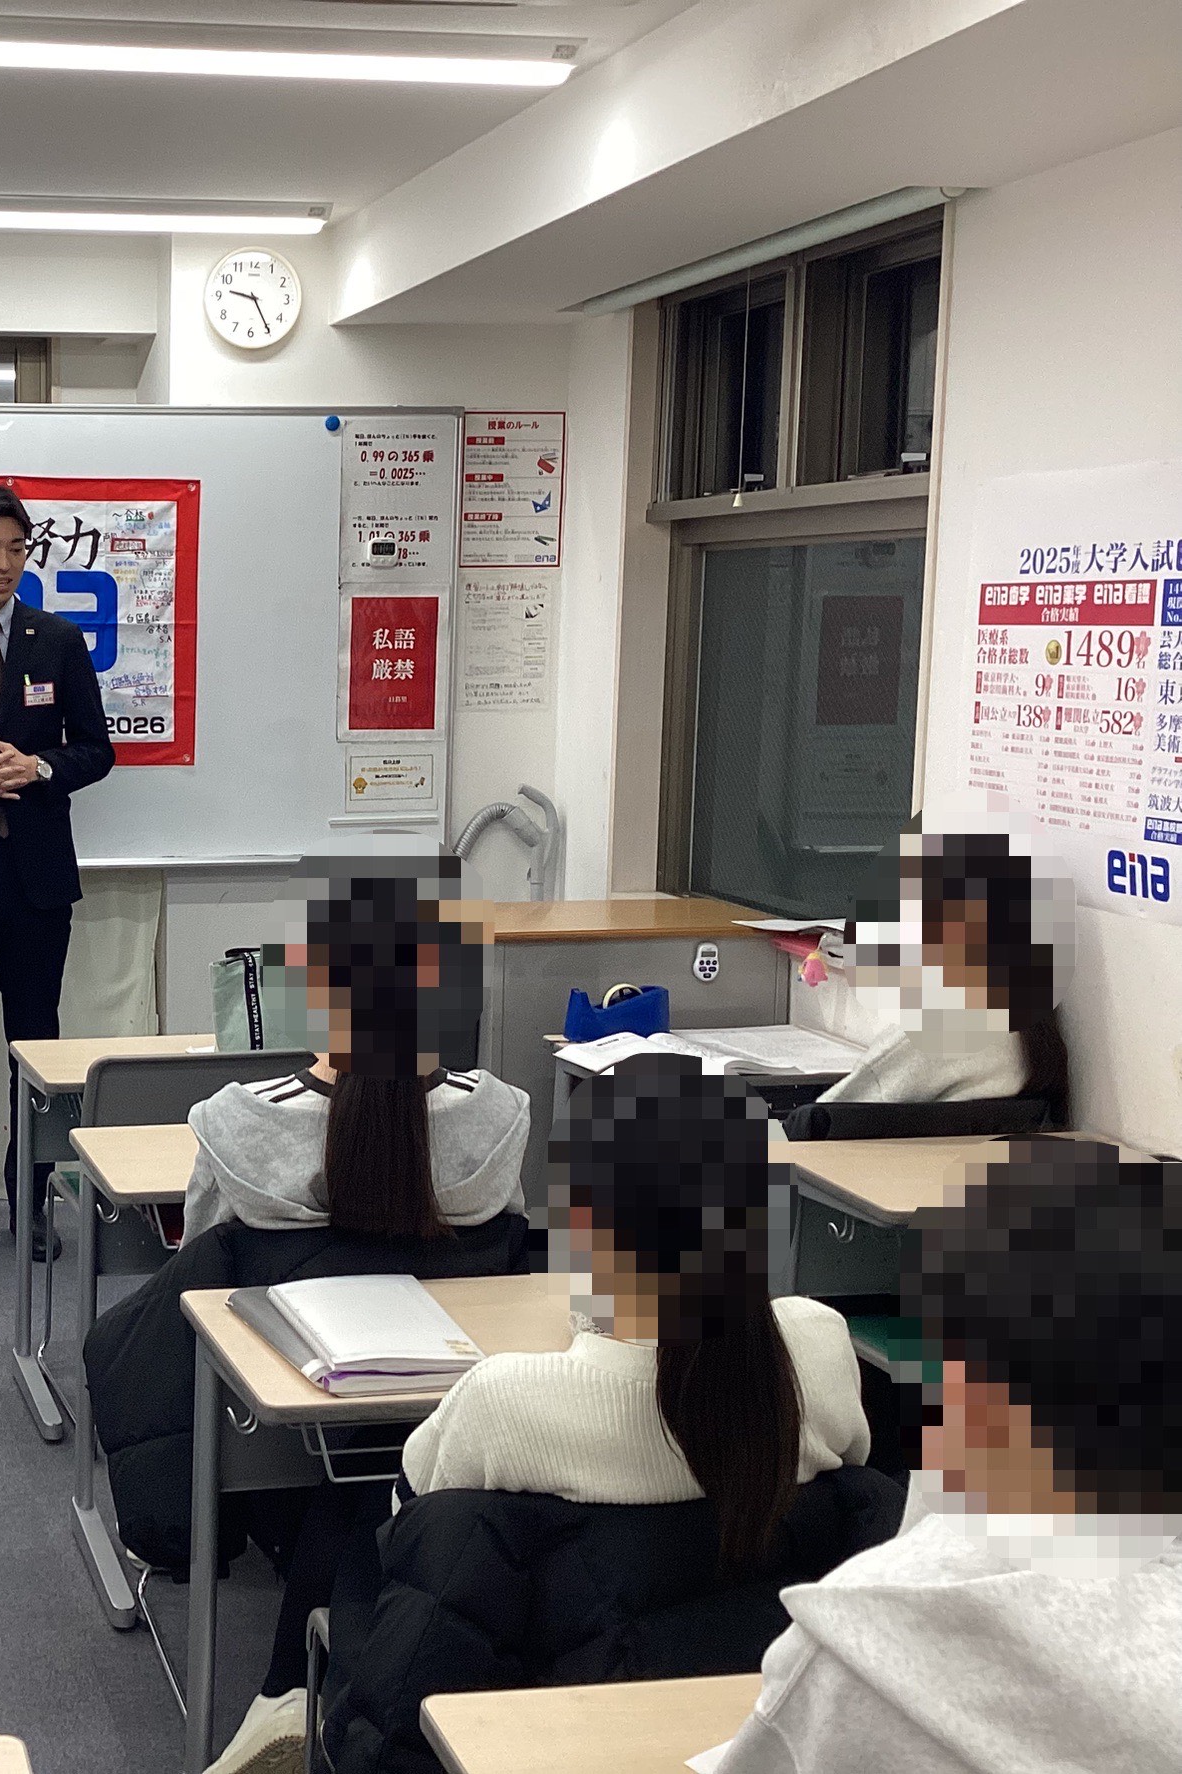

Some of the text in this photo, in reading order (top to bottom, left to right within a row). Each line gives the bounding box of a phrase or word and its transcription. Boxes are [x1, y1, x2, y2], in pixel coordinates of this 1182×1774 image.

[233, 262, 243, 272] 11
[269, 263, 274, 274] 1
[221, 274, 233, 285] 10
[280, 277, 286, 288] 2
[215, 290, 222, 301] 9
[283, 294, 290, 305] 3
[220, 309, 227, 320] 8
[276, 313, 283, 323] 4
[232, 322, 239, 332] 7
[247, 327, 254, 338] 6
[488, 421, 539, 431] 授業のルール
[1169, 583, 1182, 595] 14
[1041, 608, 1079, 623] 合格実績
[372, 628, 415, 650] 私語
[977, 628, 1009, 646] 医療系
[977, 647, 1029, 665] 合格者総数
[372, 659, 414, 680] 厳禁
[105, 716, 165, 735] 2026
[1108, 849, 1170, 902] ena
